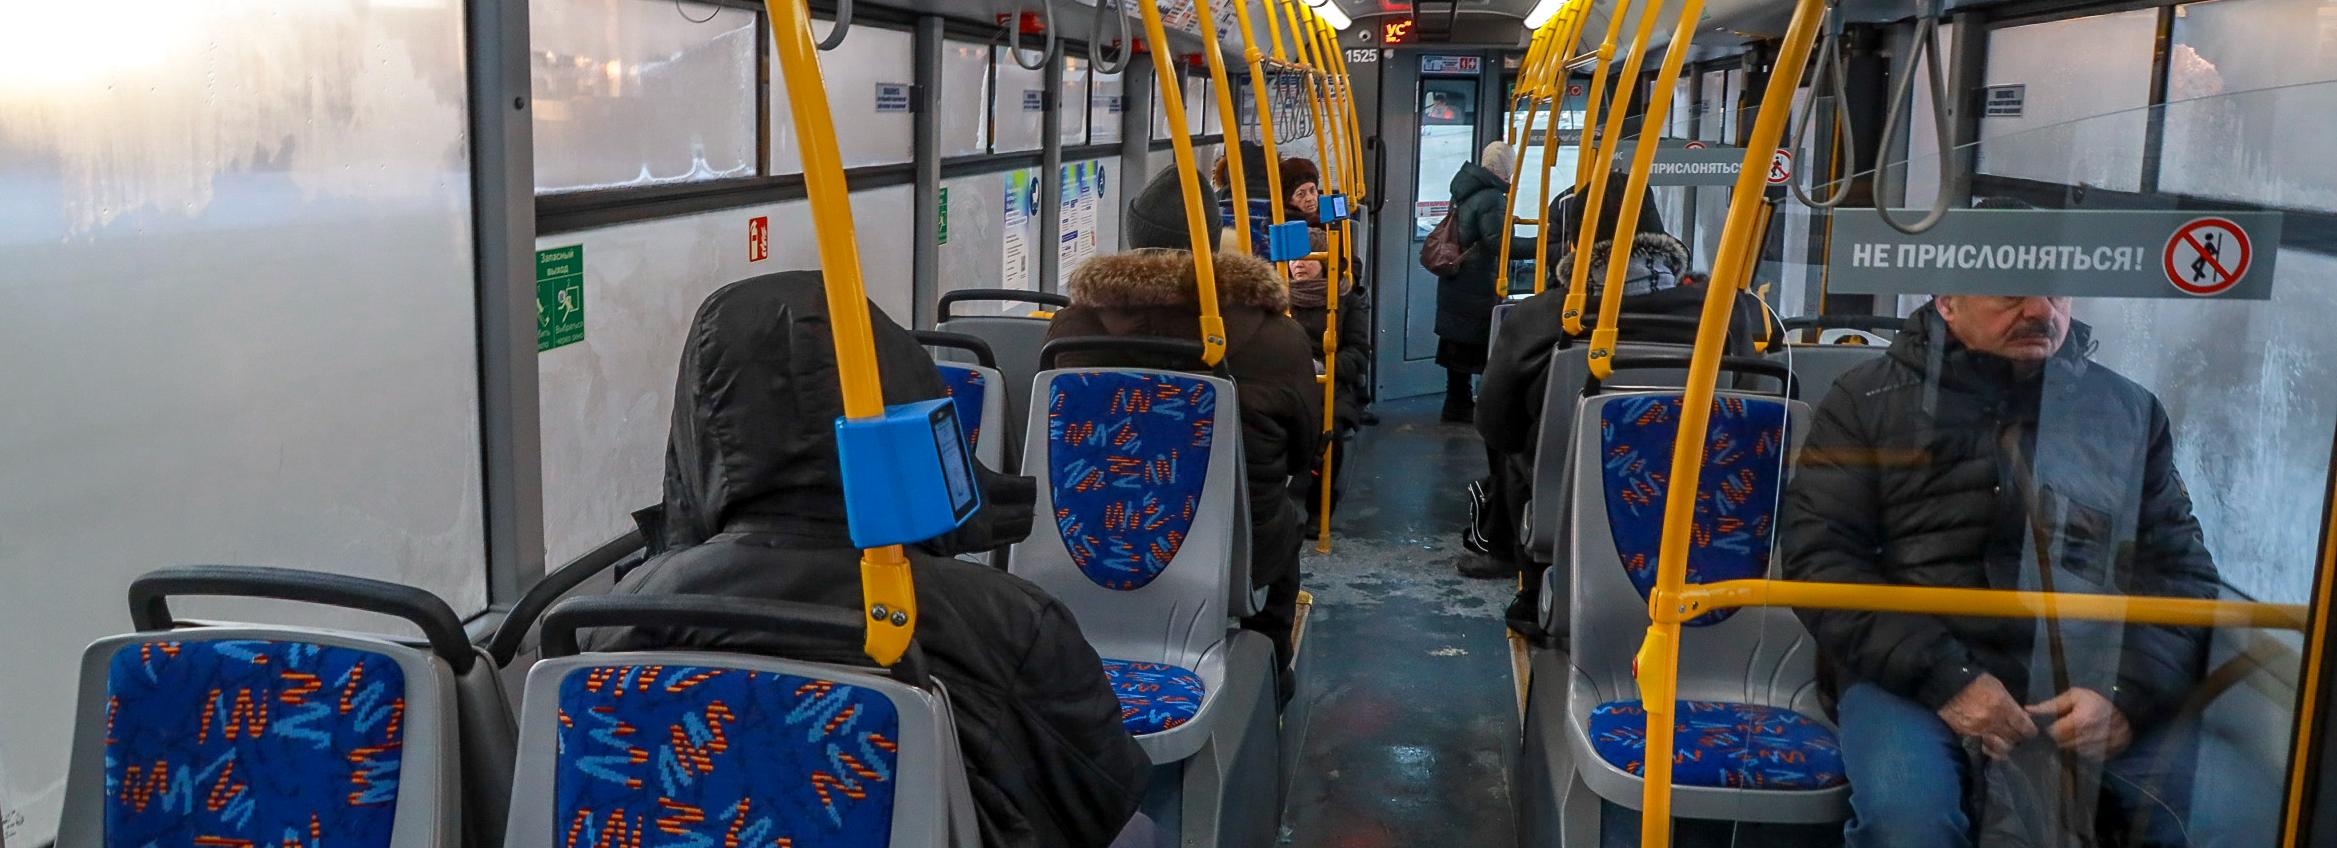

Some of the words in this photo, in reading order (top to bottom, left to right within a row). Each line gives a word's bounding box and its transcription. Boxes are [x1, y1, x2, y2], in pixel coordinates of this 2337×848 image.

[1346, 49, 1377, 62] 1525
[1852, 243, 1891, 267] НЕ
[1896, 245, 2143, 271] ПРИСЛОНЯТЬСЯ!
